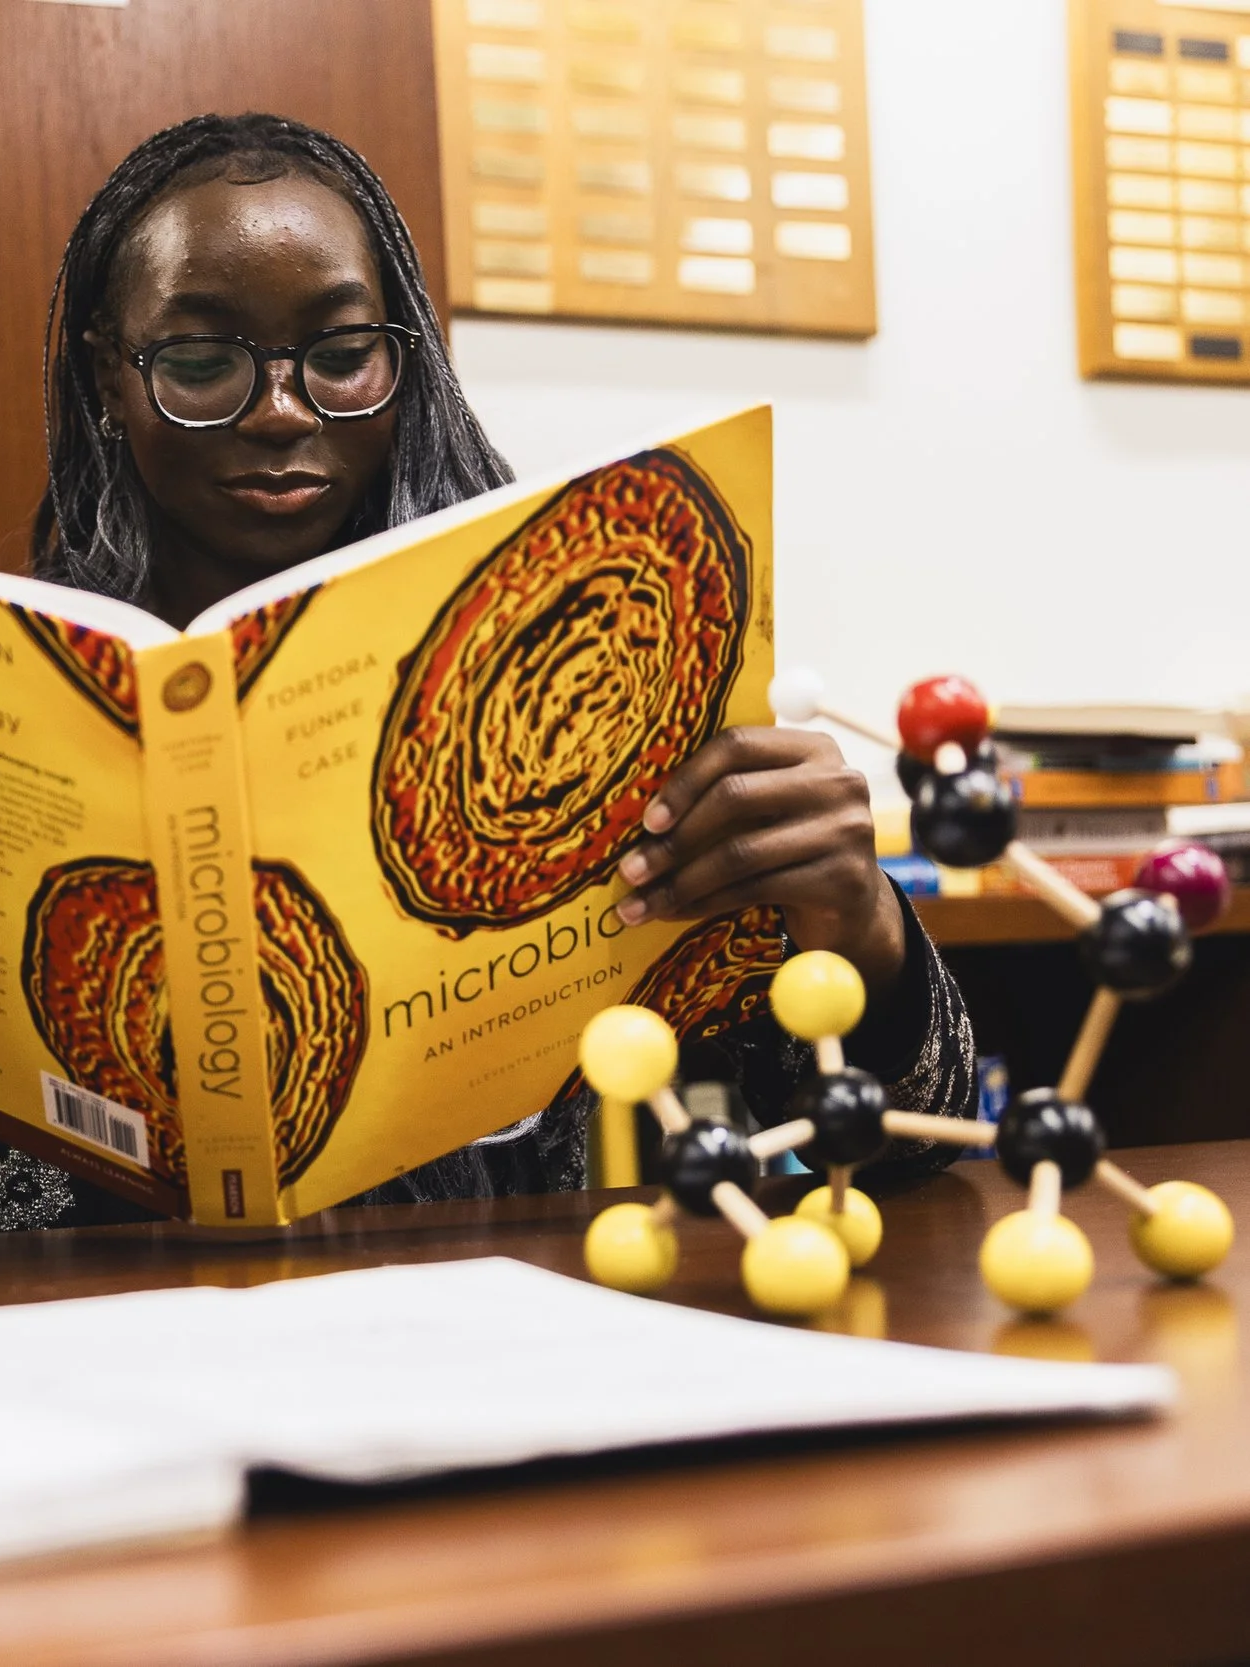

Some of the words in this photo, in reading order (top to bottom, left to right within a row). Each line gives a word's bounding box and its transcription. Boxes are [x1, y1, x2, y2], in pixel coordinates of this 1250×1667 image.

[266, 652, 378, 711] TORTORA
[285, 697, 363, 742] FUNKE
[298, 740, 358, 779] CASE
[184, 804, 249, 1100] microbiology
[384, 904, 626, 1038] microbio
[423, 1037, 454, 1062] AN
[461, 961, 624, 1045] INTRODUCTION
